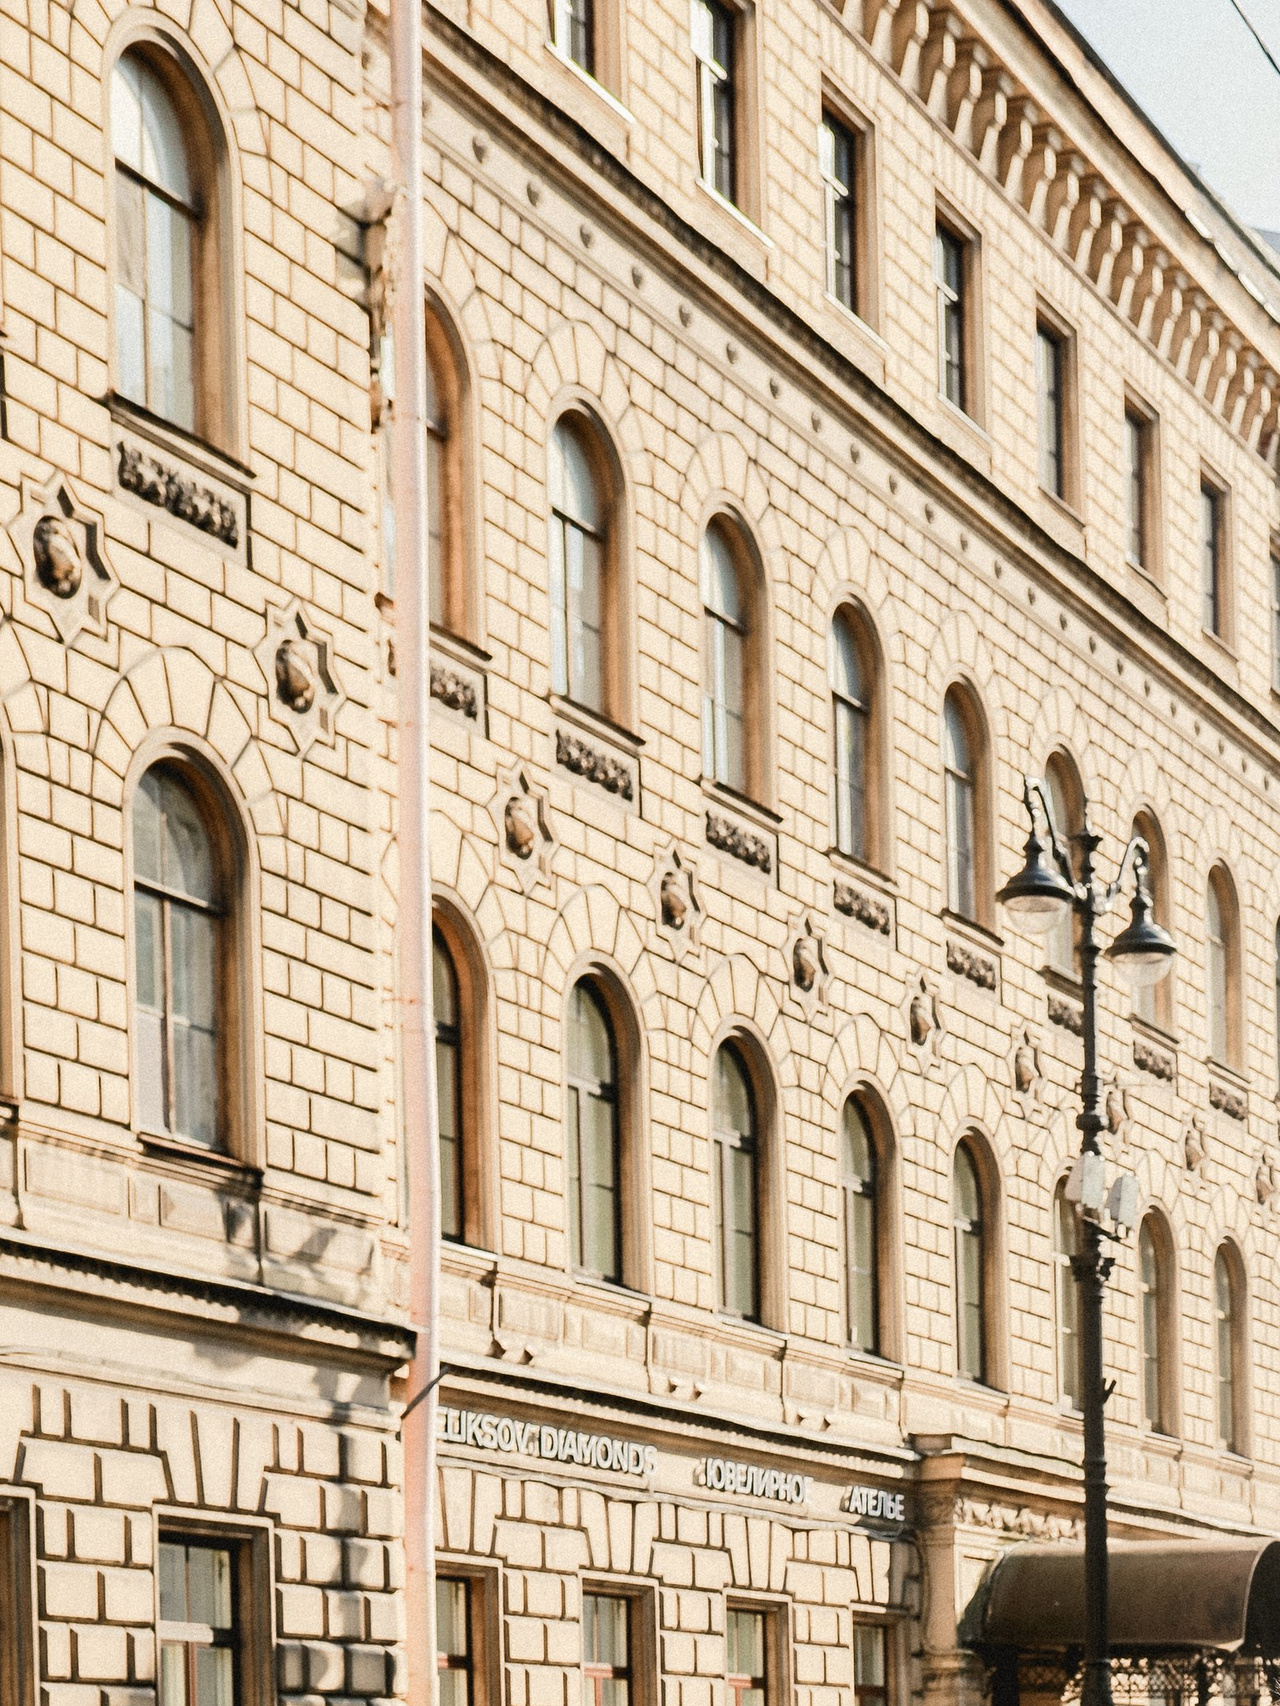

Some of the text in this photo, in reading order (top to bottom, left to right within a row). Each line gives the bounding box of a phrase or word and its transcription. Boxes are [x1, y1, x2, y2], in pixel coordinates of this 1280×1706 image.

[540, 1425, 658, 1476] DIAMONDS
[706, 1458, 905, 1521] ЮВЕЛИРНОЕ АТЕЛЬЕ
